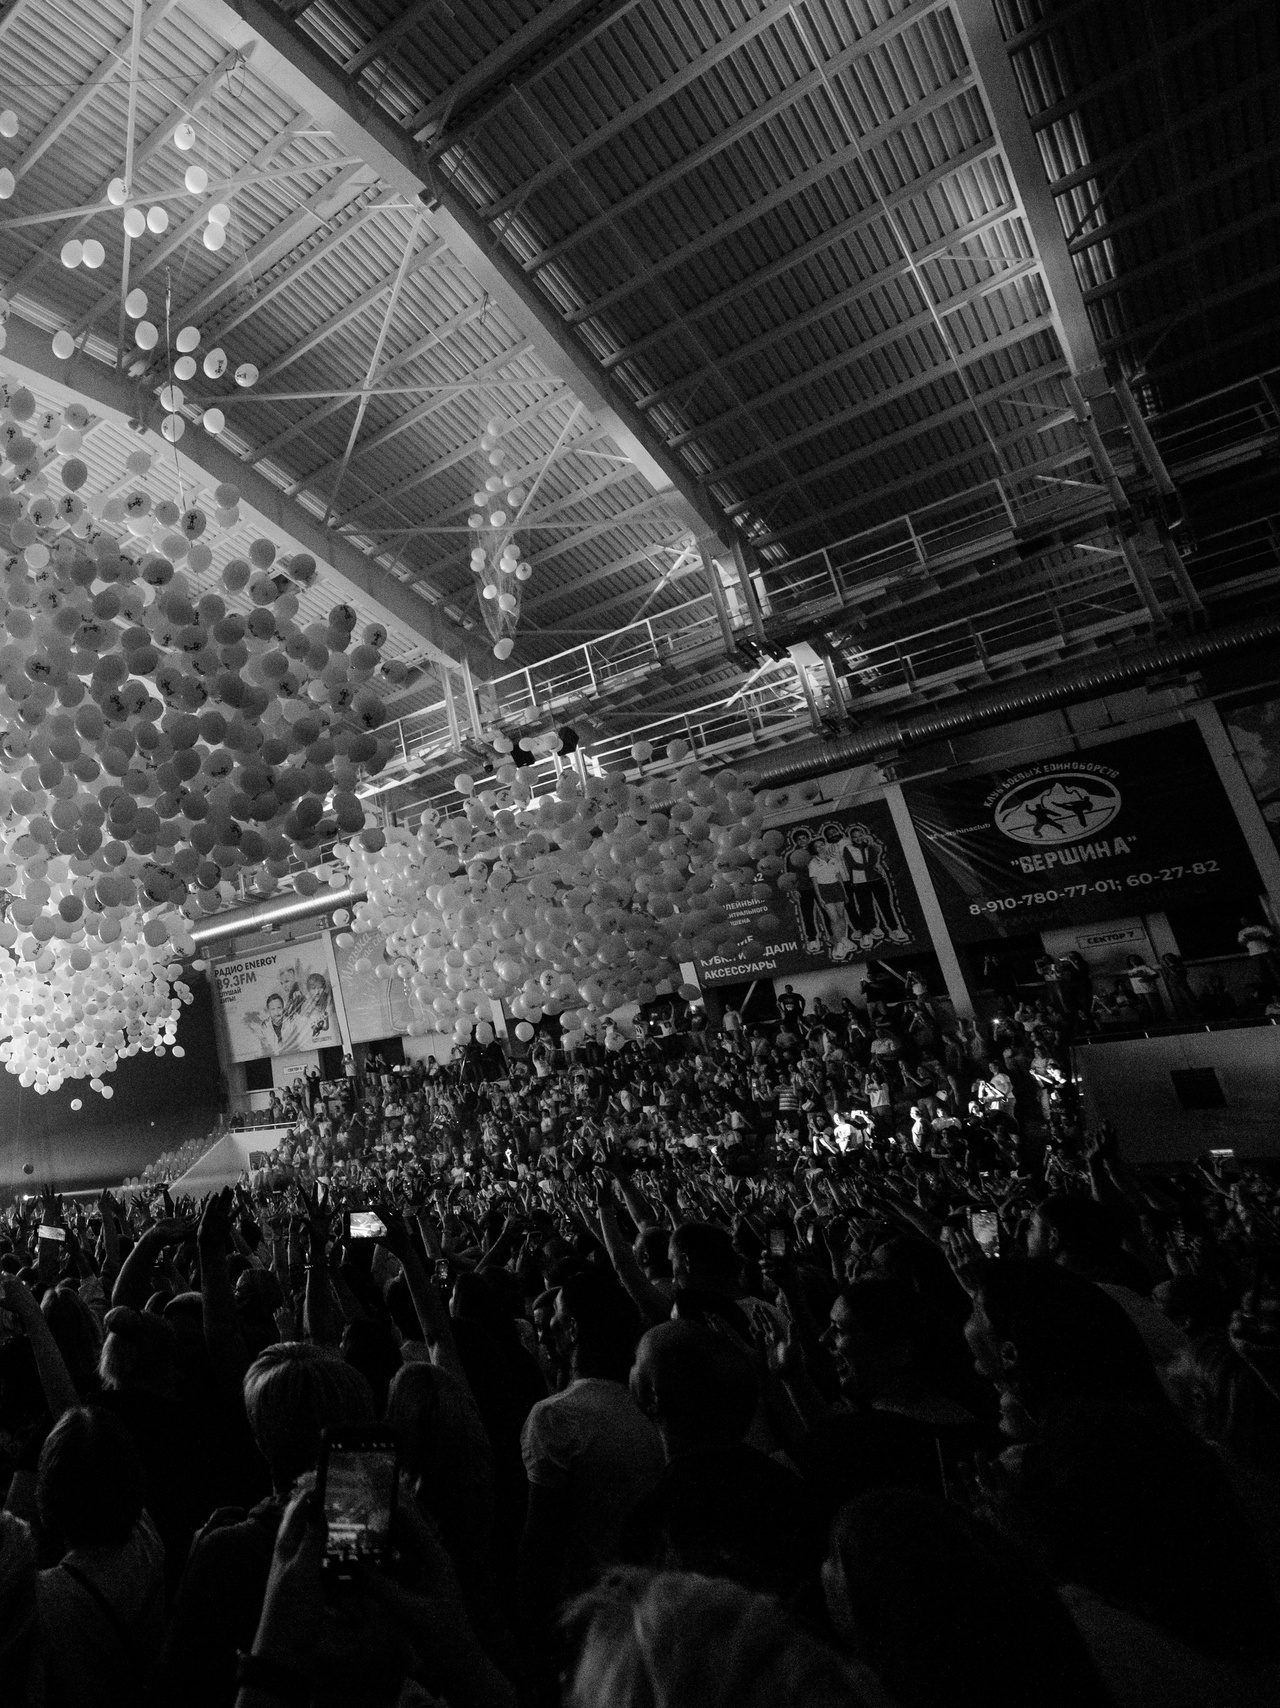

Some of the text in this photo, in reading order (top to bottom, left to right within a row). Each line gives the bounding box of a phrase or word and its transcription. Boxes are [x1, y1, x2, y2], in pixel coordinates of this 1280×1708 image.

[984, 762, 1120, 808] КЛУБ БОЕВЫХ ЕДИНОБОРСТВ
[969, 878, 1123, 916] 8-910-780-77-01;
[1126, 859, 1220, 888] 60-27-82
[1087, 933, 1125, 944] СЕКТОР
[763, 941, 798, 957] ДАЛИ
[214, 955, 277, 977] РАДИО ENERGY
[704, 960, 777, 980] АКСЕССУАРЫ
[216, 971, 257, 990] 89.3FM
